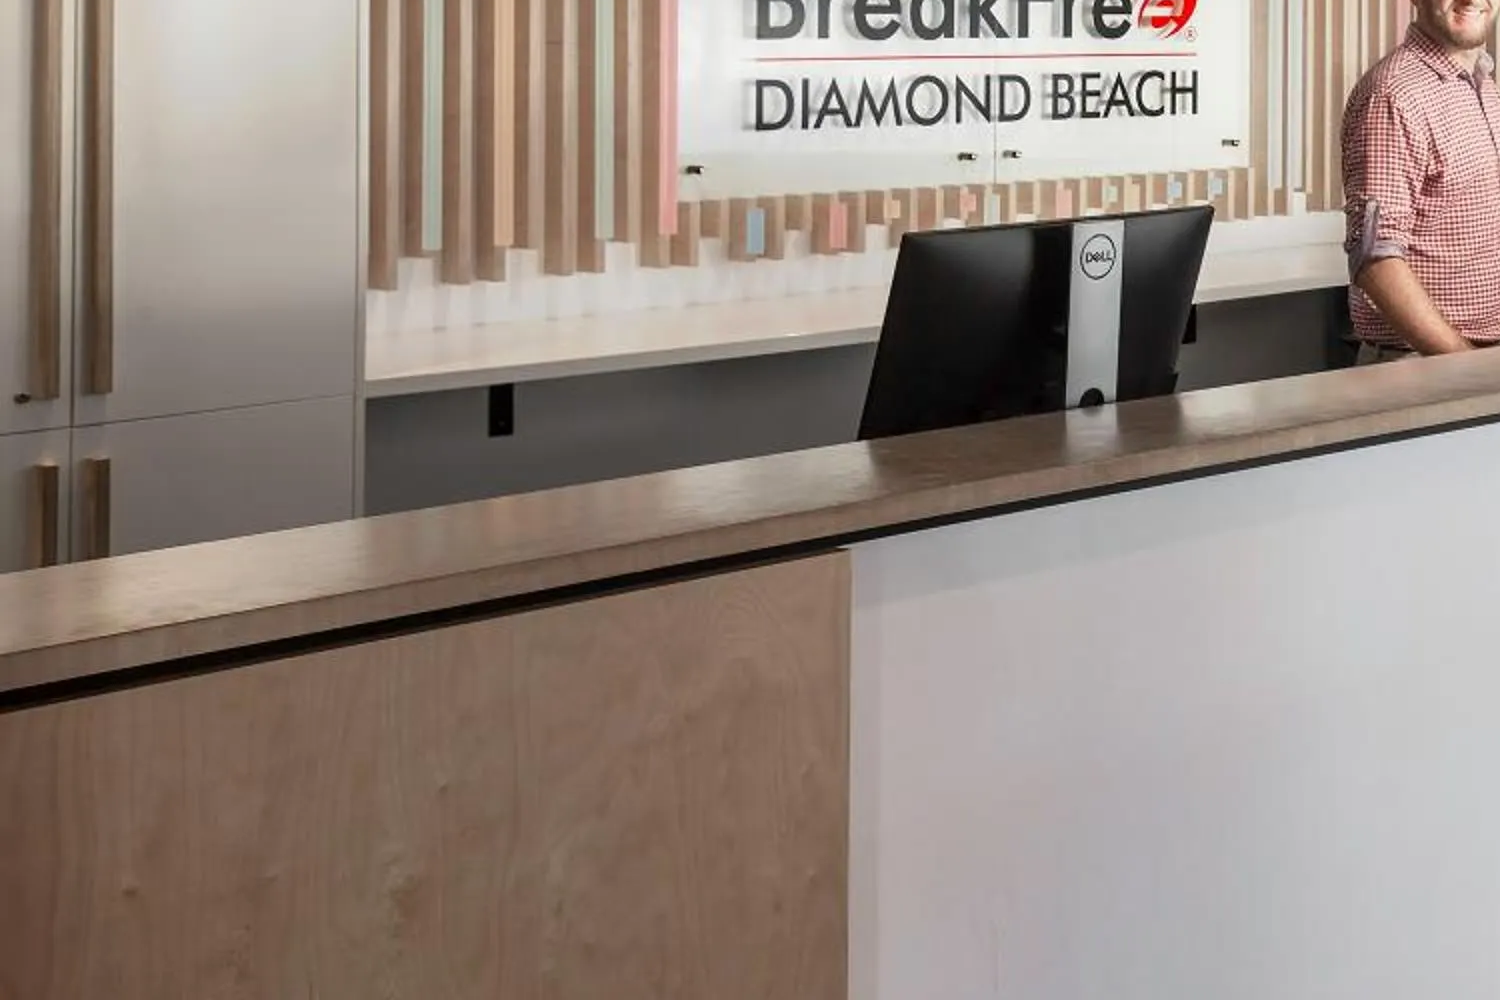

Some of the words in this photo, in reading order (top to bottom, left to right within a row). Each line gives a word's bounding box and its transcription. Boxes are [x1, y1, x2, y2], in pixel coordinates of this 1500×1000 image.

[755, 75, 1031, 131] DIAMOND
[1051, 70, 1199, 121] BEACH
[1085, 250, 1113, 263] DELL
